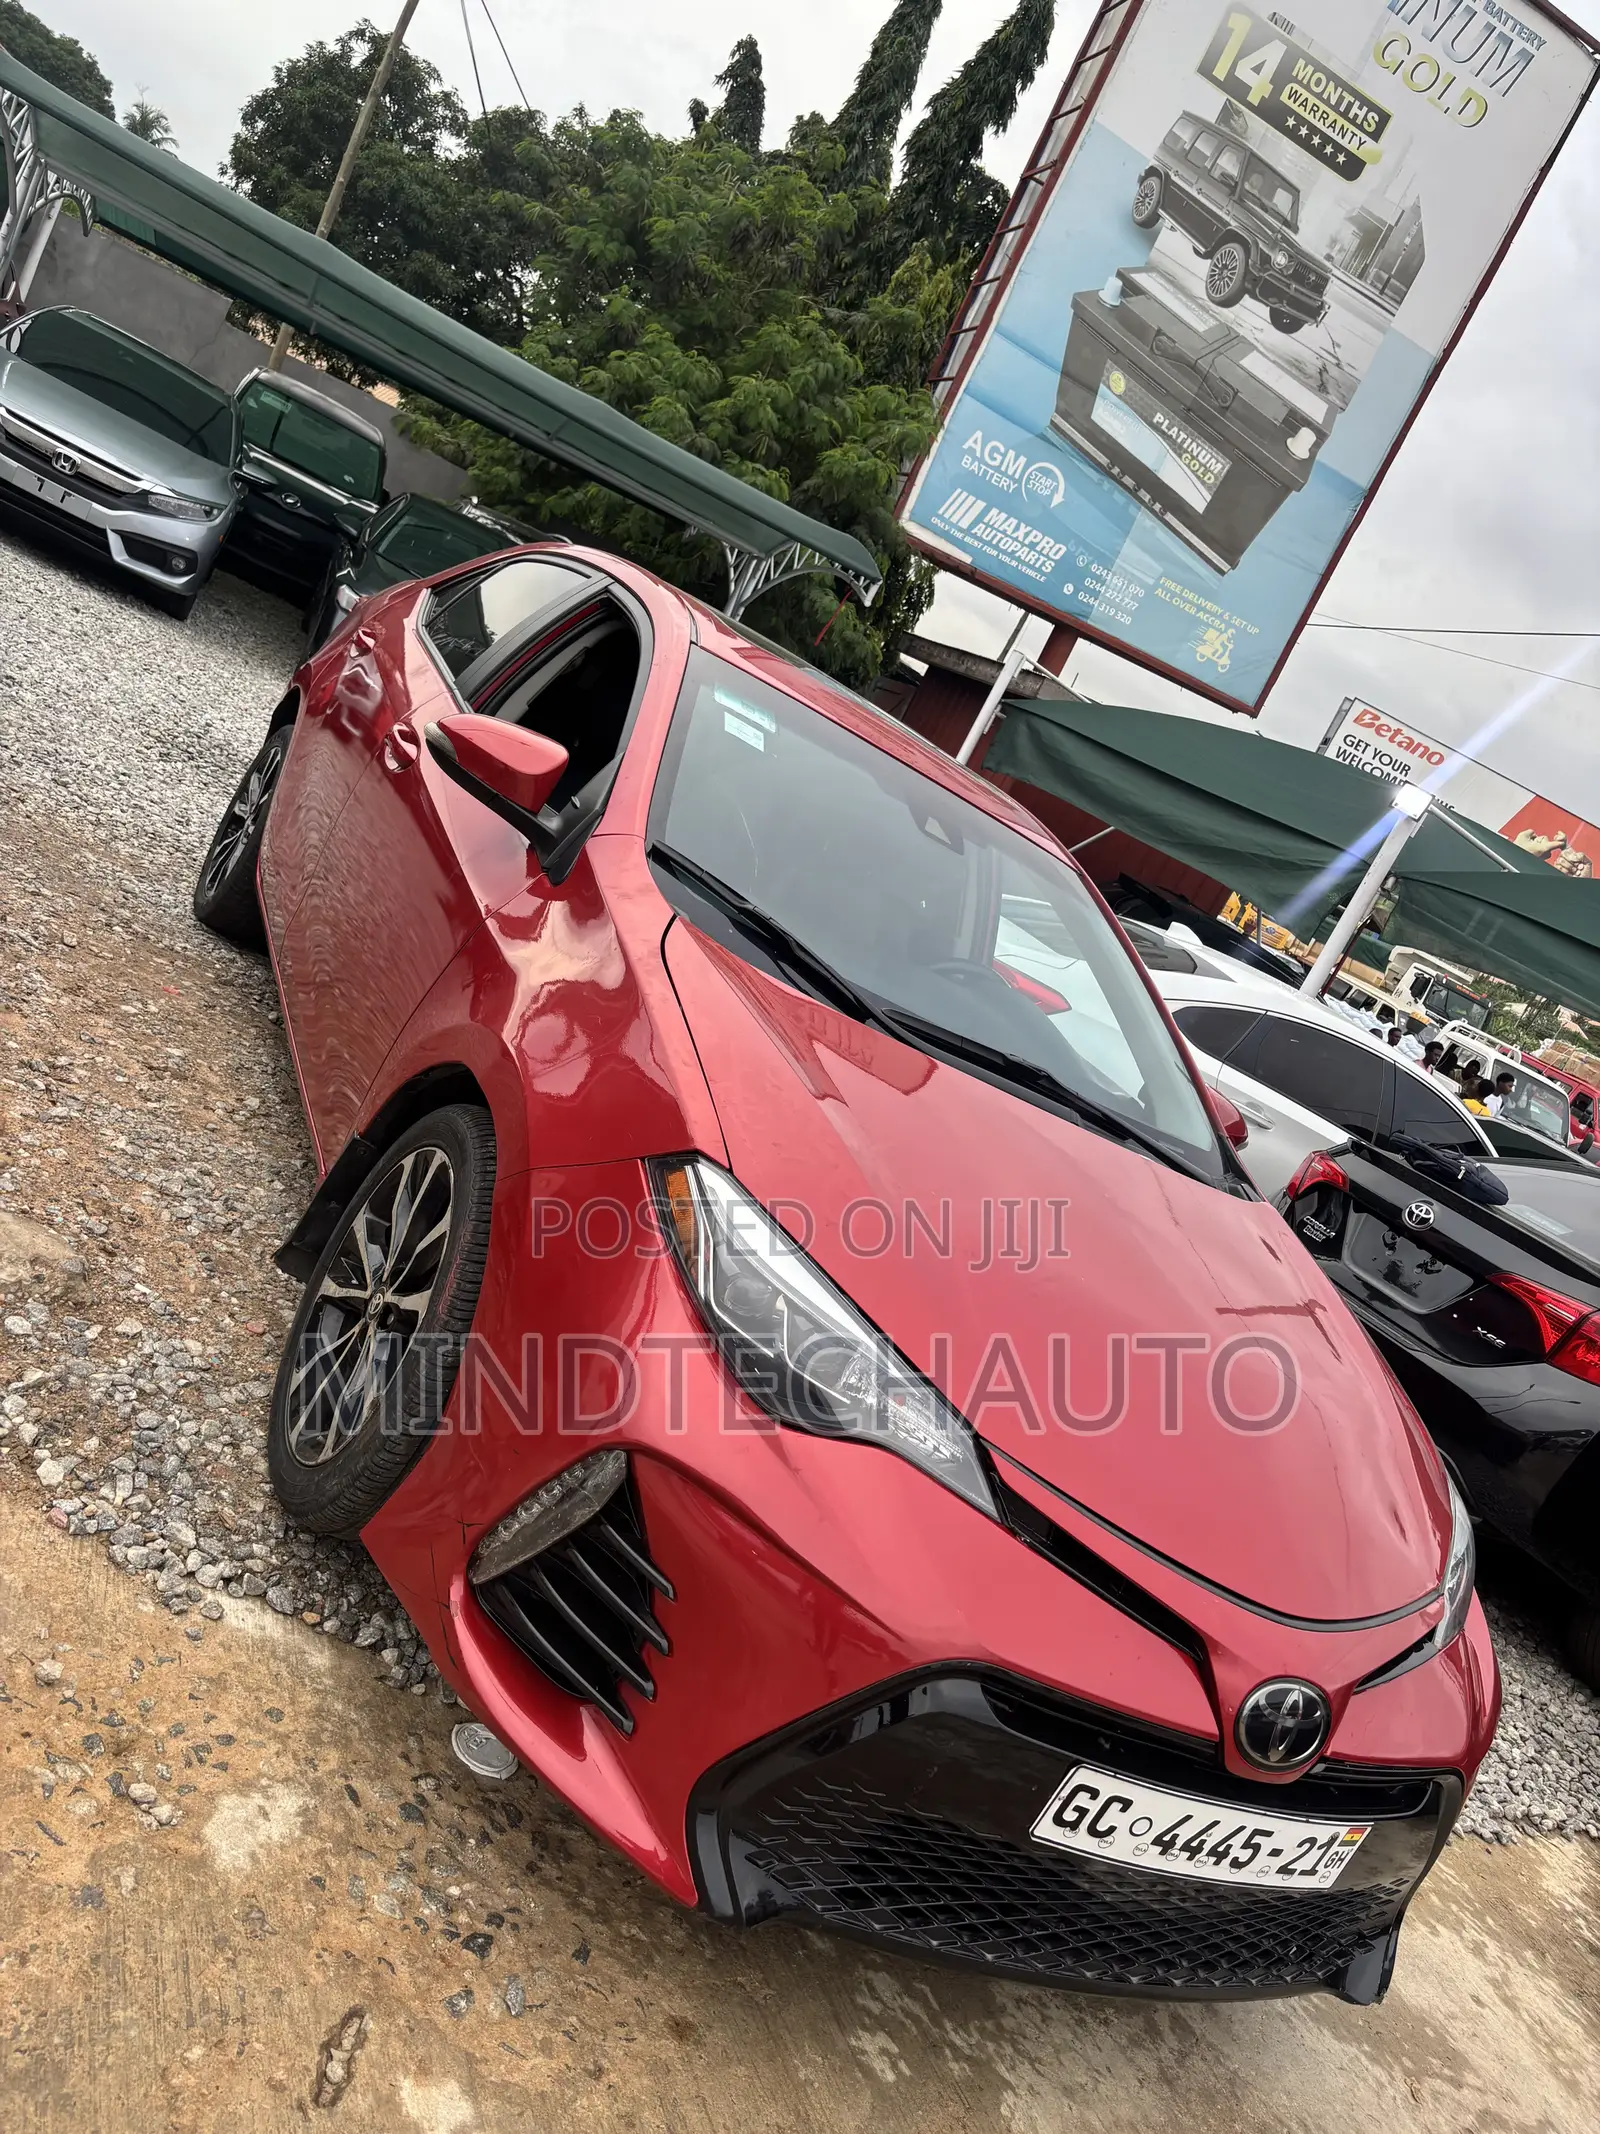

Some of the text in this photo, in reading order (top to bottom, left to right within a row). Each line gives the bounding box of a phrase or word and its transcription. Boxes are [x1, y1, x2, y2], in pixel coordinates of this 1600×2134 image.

[1483, 1, 1548, 52] BATTERY
[1212, 12, 1288, 107] 14
[1373, 30, 1488, 128] GOLD
[1287, 86, 1368, 151] WARRANTY
[1291, 57, 1379, 133] MONTHS
[962, 429, 1027, 480] AGM
[1152, 412, 1223, 475] PLATINUM
[1181, 453, 1215, 484] GOLD
[961, 455, 1018, 494] BATTERY
[1027, 479, 1052, 496] STOP
[1029, 471, 1058, 490] START
[931, 516, 1047, 583] ONLY THE BEST FOR YOUR VEHICLE
[971, 522, 1056, 573] AUTOPARTS
[983, 507, 1067, 561] MAXPRO
[1084, 577, 1139, 611] 0244 272 777
[1091, 562, 1112, 580] 0243
[1128, 583, 1145, 598] 070
[1159, 576, 1260, 635] FREE DELIVERY & SET UP
[1077, 591, 1132, 625] 0244 319 320
[1154, 587, 1226, 632] ALL OVER ACCRA
[1343, 734, 1411, 778] GET YOUR
[1352, 708, 1445, 766] Betano
[1303, 1215, 1336, 1238] COROLLA
[1052, 1783, 1340, 1876] GC 4445-21
[1323, 1850, 1350, 1870] GH
